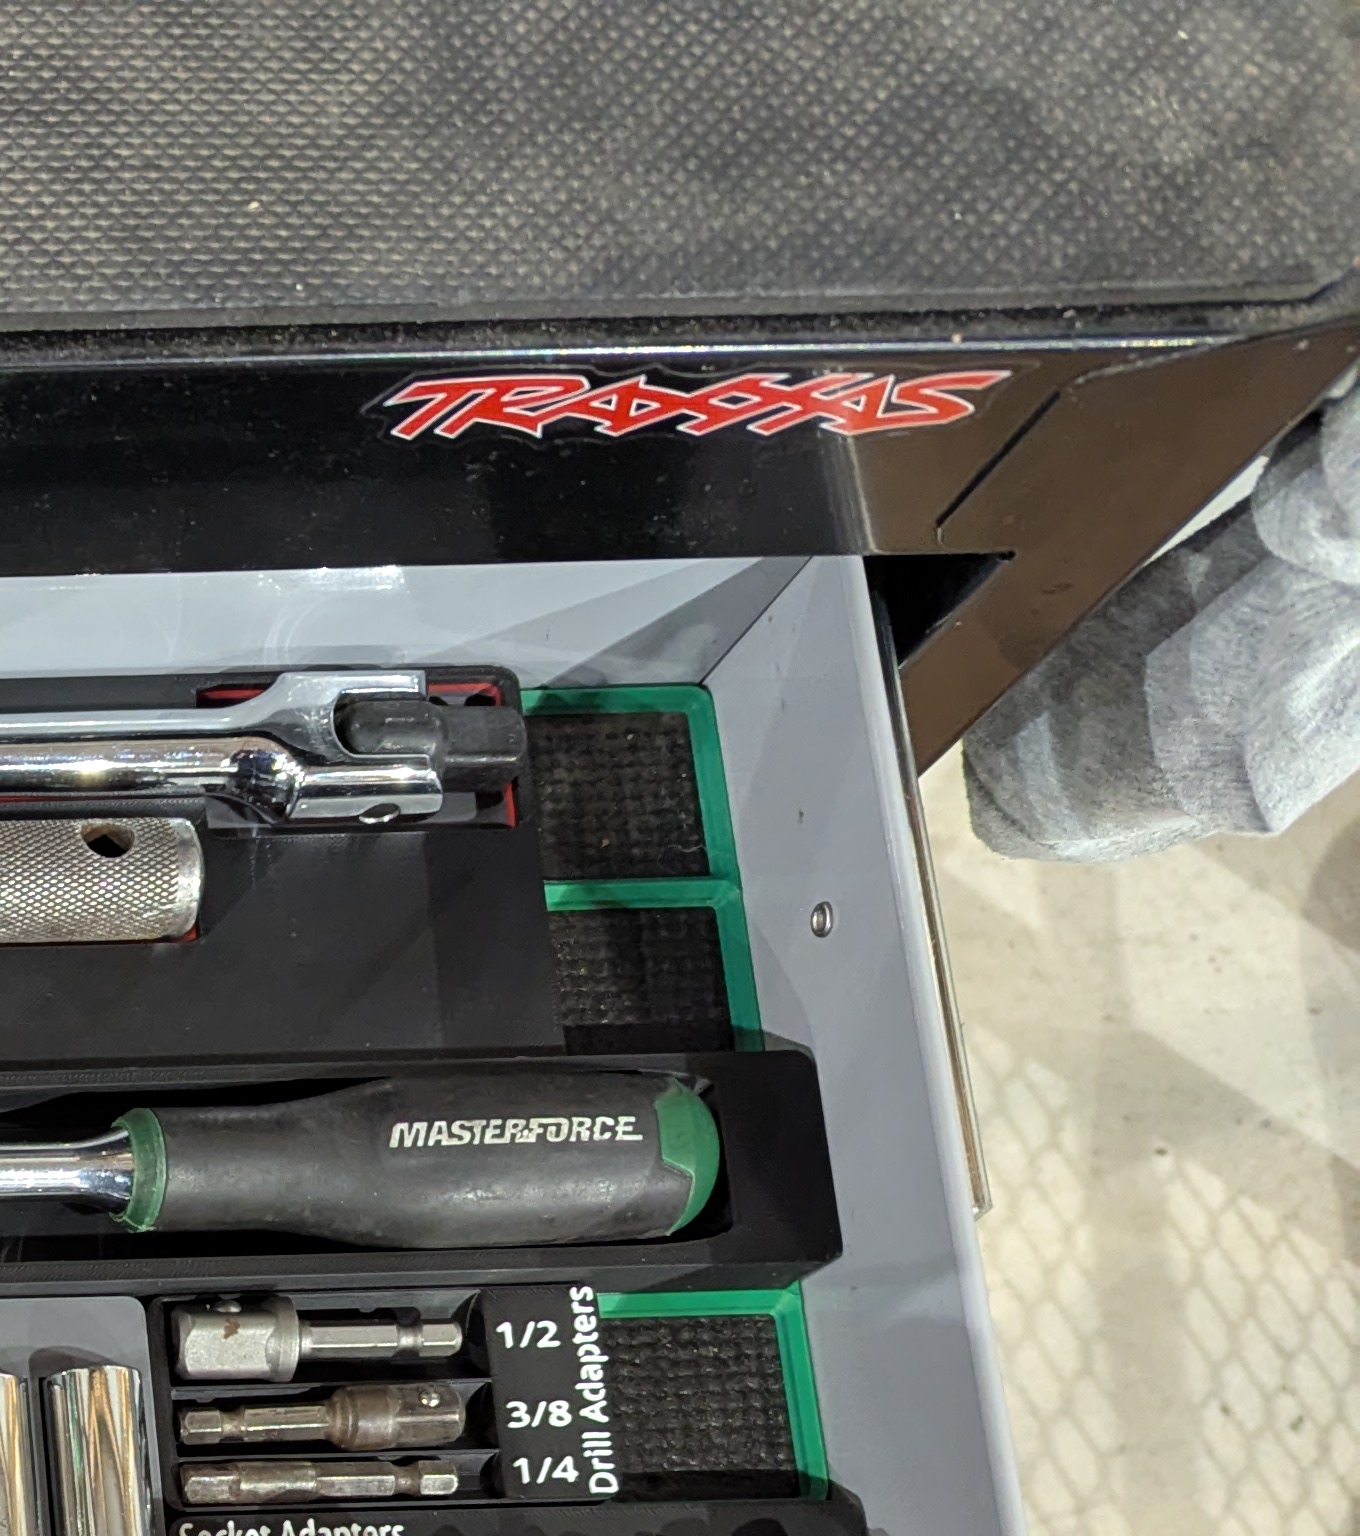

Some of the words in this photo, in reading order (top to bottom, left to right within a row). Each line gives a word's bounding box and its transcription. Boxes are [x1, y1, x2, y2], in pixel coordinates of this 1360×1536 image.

[384, 370, 1012, 438] TRAXXAS
[390, 1116, 643, 1148] MASTERFORCE
[496, 1321, 561, 1348] 1/2
[571, 1287, 610, 1421] Adapters
[506, 1400, 572, 1428] 3/8
[514, 1456, 579, 1484] 1/4
[582, 1430, 618, 1495] Drill
